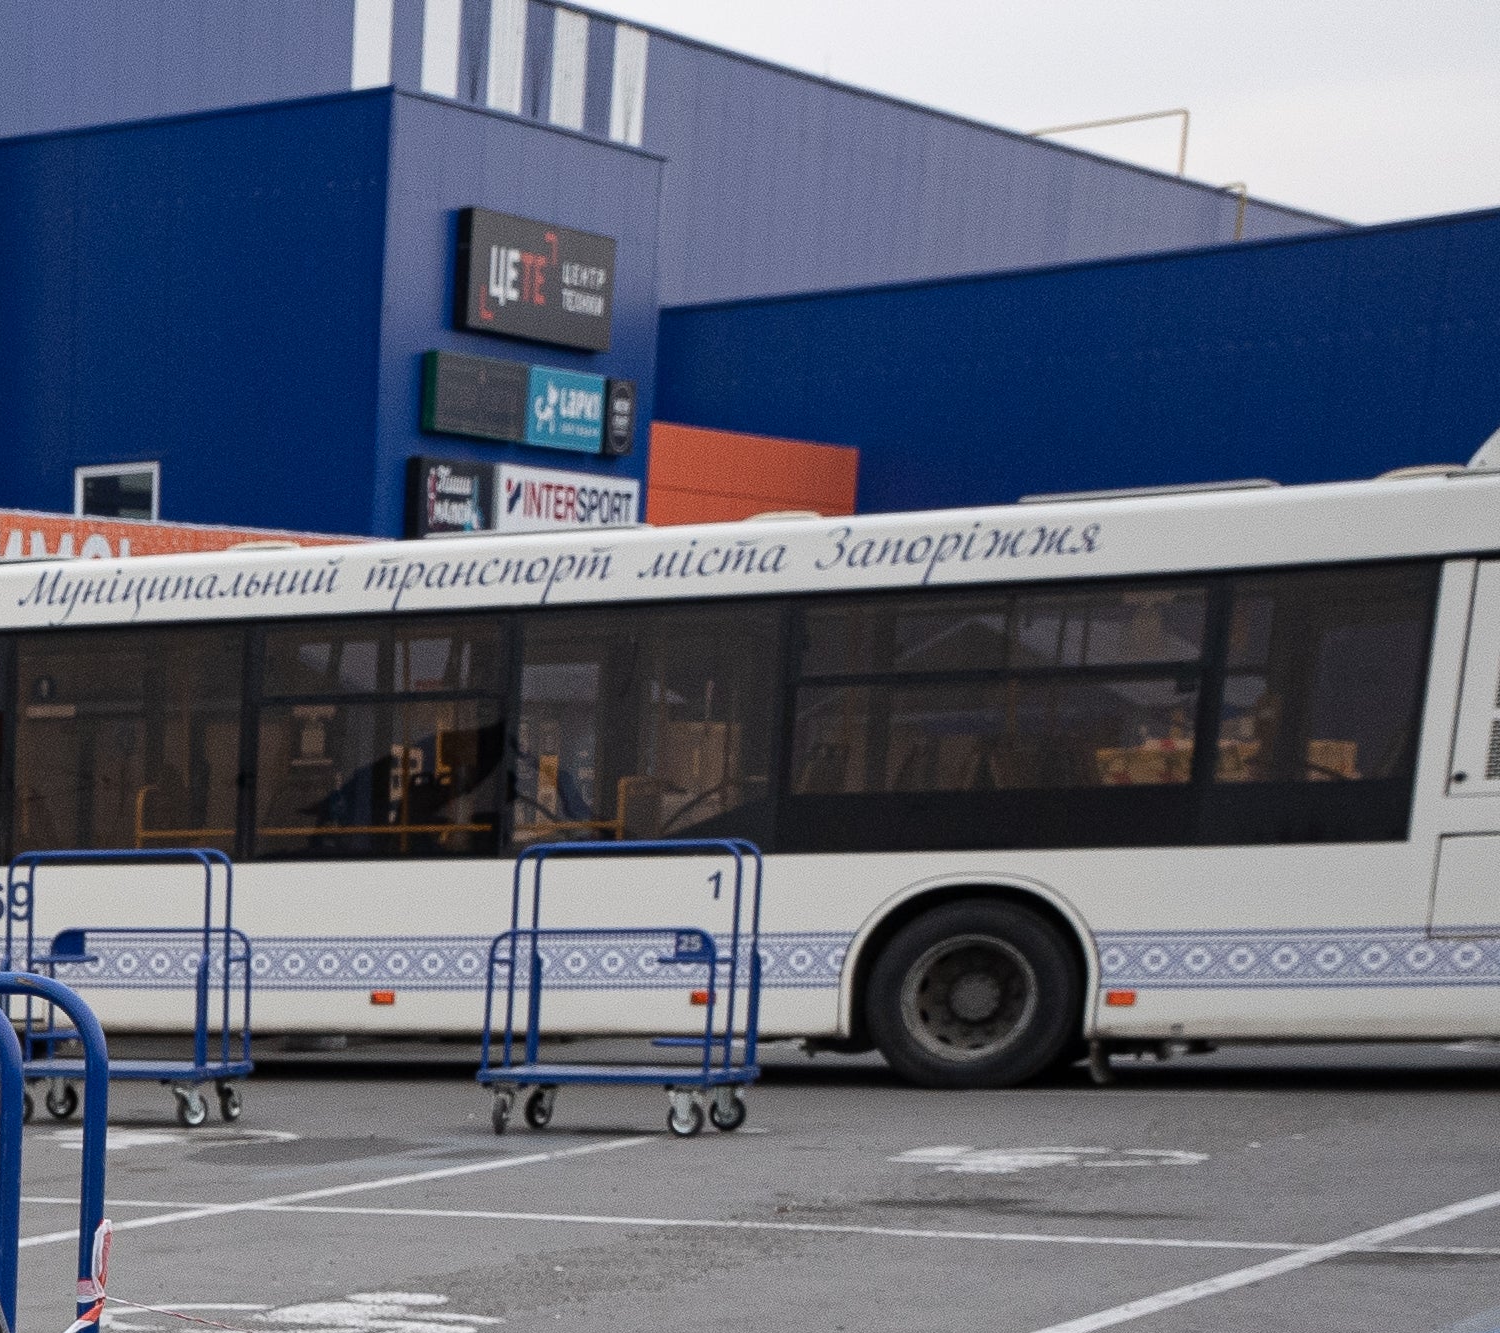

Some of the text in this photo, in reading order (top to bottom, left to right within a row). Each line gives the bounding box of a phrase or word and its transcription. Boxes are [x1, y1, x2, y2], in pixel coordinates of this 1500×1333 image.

[523, 479, 633, 523] INTERSPORT
[18, 521, 1102, 622] Муніципальний транспорт міста Запоріжжя
